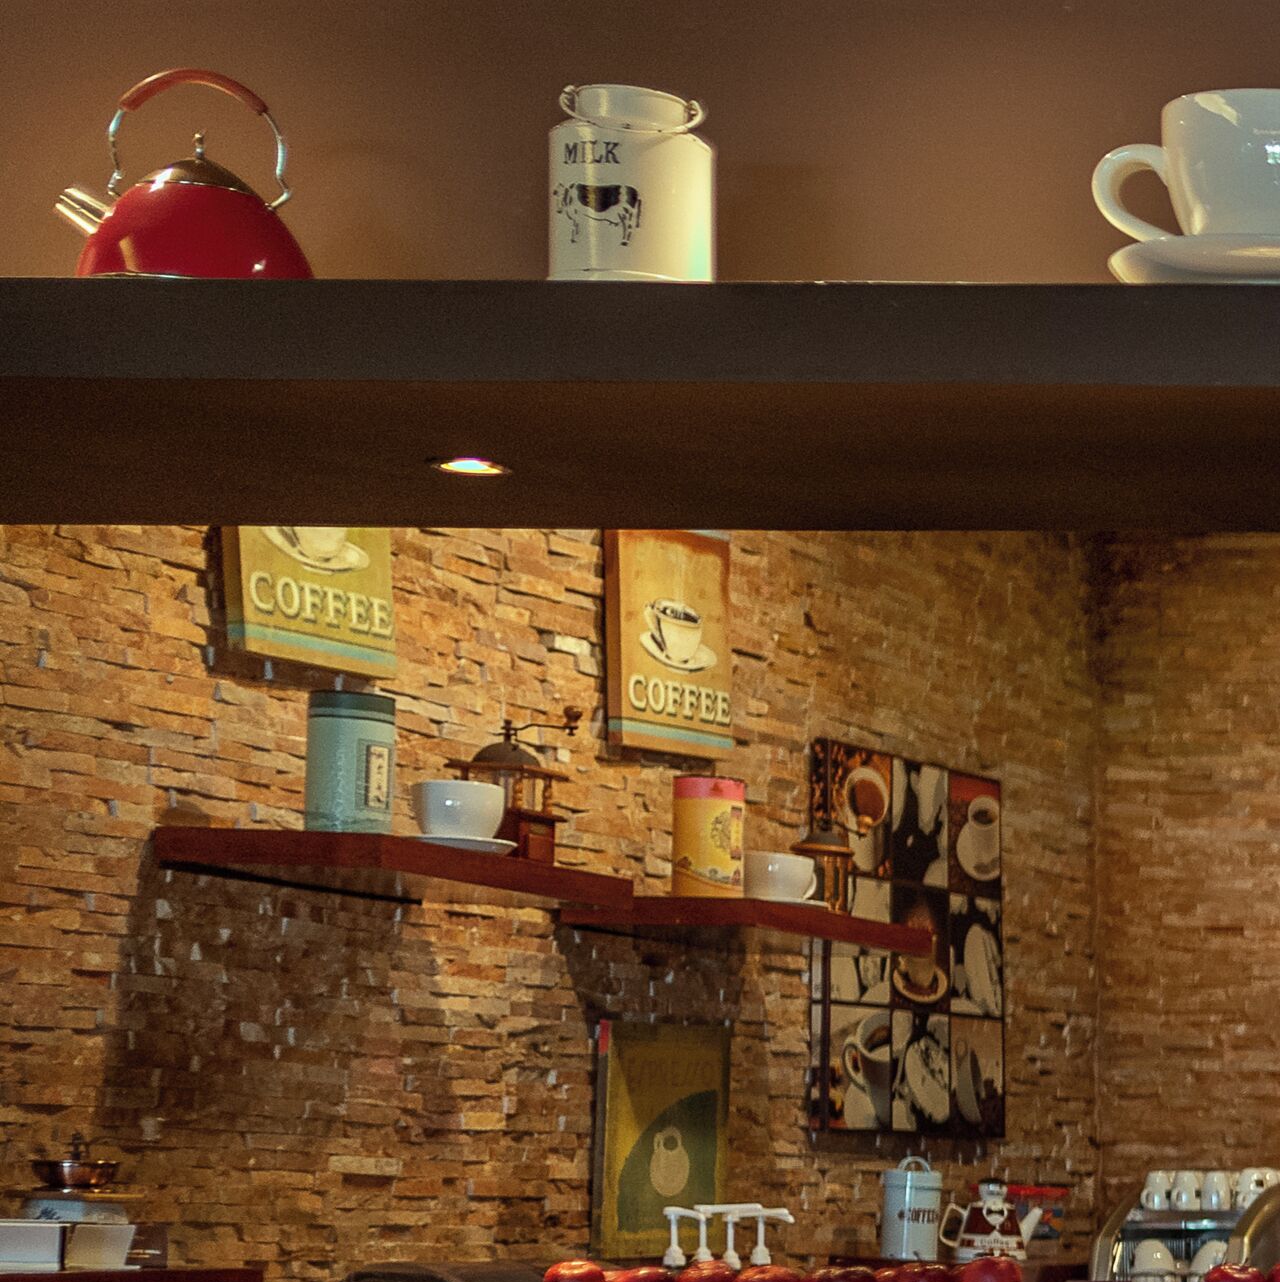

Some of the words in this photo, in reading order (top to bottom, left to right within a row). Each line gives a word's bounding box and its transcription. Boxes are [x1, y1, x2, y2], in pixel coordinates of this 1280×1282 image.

[563, 140, 621, 164] MILK
[250, 571, 394, 639] COFFEE
[627, 673, 732, 726] COFFEE
